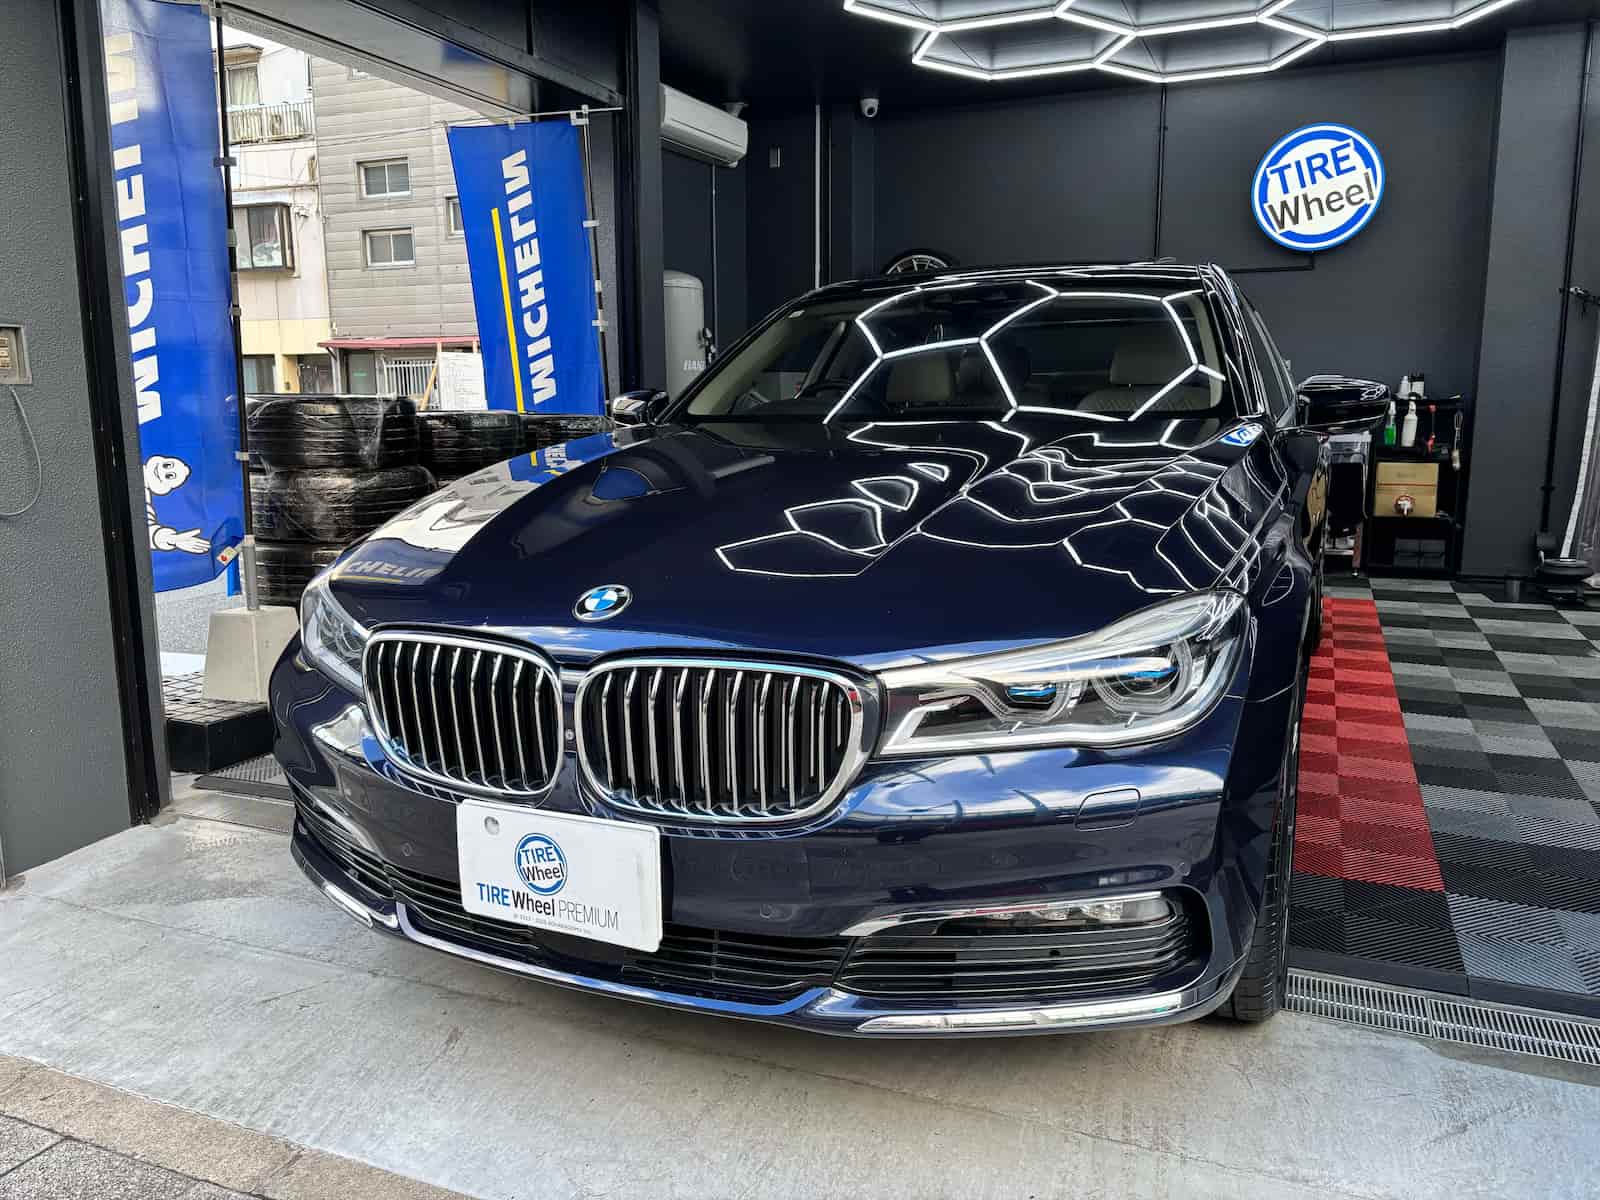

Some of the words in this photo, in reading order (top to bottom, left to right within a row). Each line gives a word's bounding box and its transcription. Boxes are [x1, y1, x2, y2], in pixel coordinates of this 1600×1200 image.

[1269, 142, 1357, 195] TIRE
[1267, 171, 1375, 230] Wheel
[521, 846, 556, 864] TIRE
[522, 863, 565, 882] Wheel
[476, 882, 511, 906] TIRE
[512, 890, 555, 917] Wheel
[558, 901, 619, 931] PREMIUM
